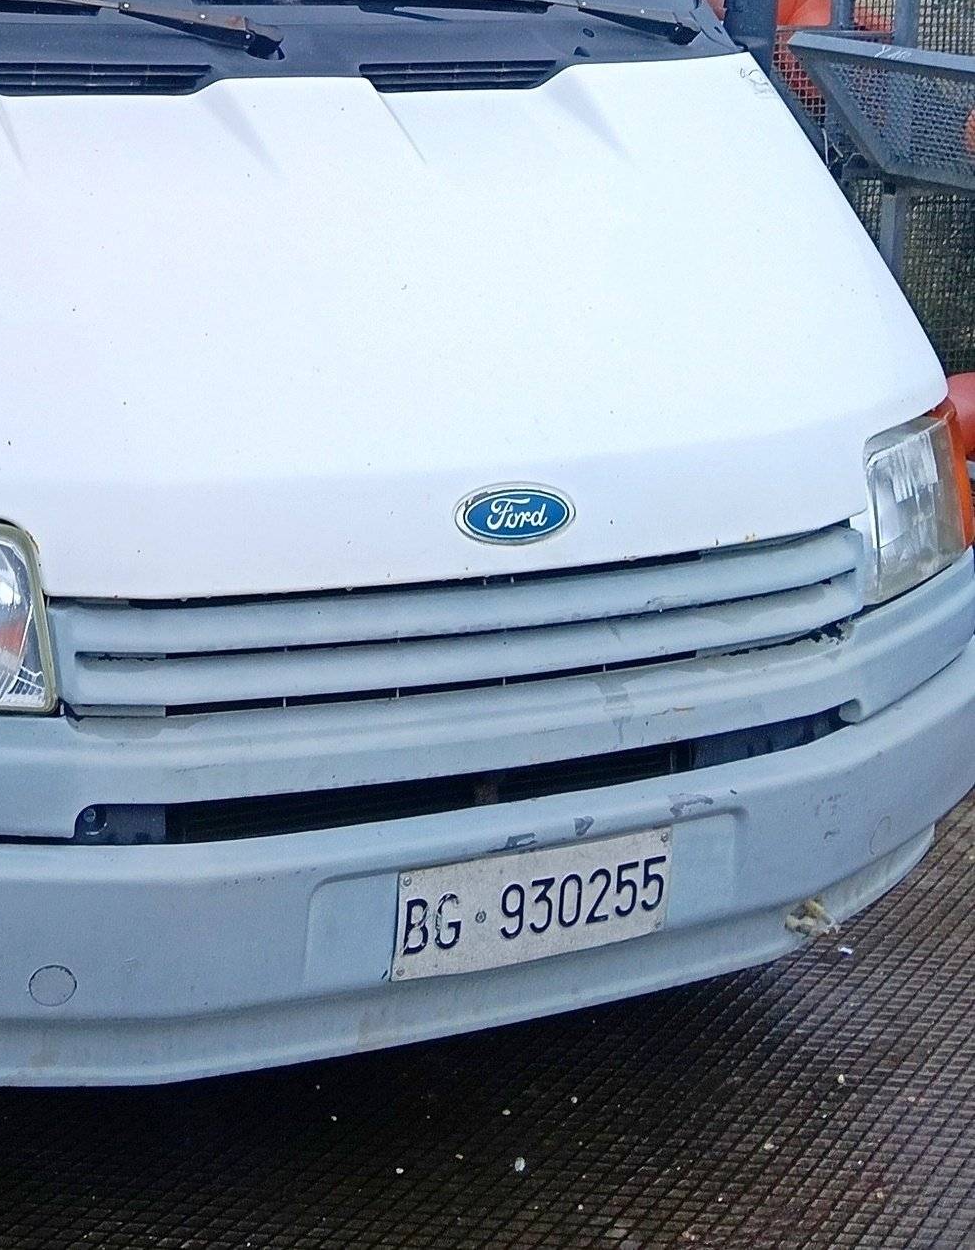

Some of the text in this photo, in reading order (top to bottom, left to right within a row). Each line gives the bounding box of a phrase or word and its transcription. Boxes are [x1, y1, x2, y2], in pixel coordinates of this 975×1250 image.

[486, 497, 548, 531] Ford
[402, 855, 667, 955] BG 930255
